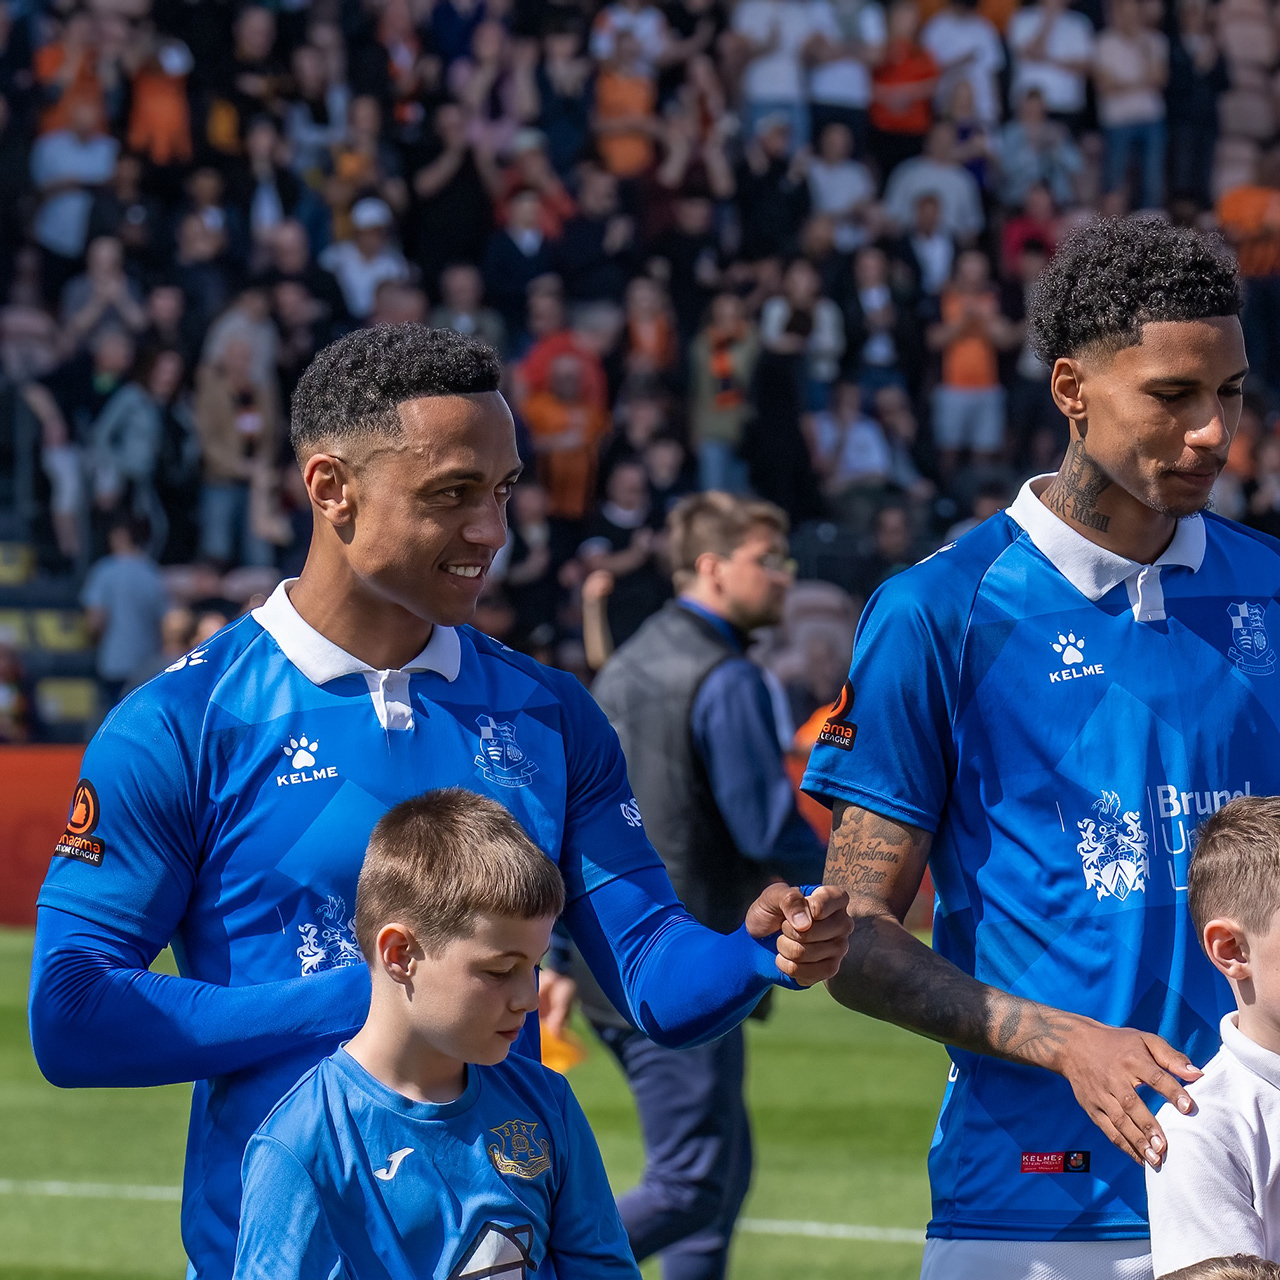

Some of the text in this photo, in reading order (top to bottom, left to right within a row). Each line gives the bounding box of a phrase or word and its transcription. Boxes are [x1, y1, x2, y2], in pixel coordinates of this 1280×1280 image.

[1049, 664, 1105, 684] KELME
[820, 732, 851, 746] LEAGUE
[276, 766, 339, 787] KELME
[59, 834, 101, 854] narama
[71, 847, 100, 862] LEAGUE
